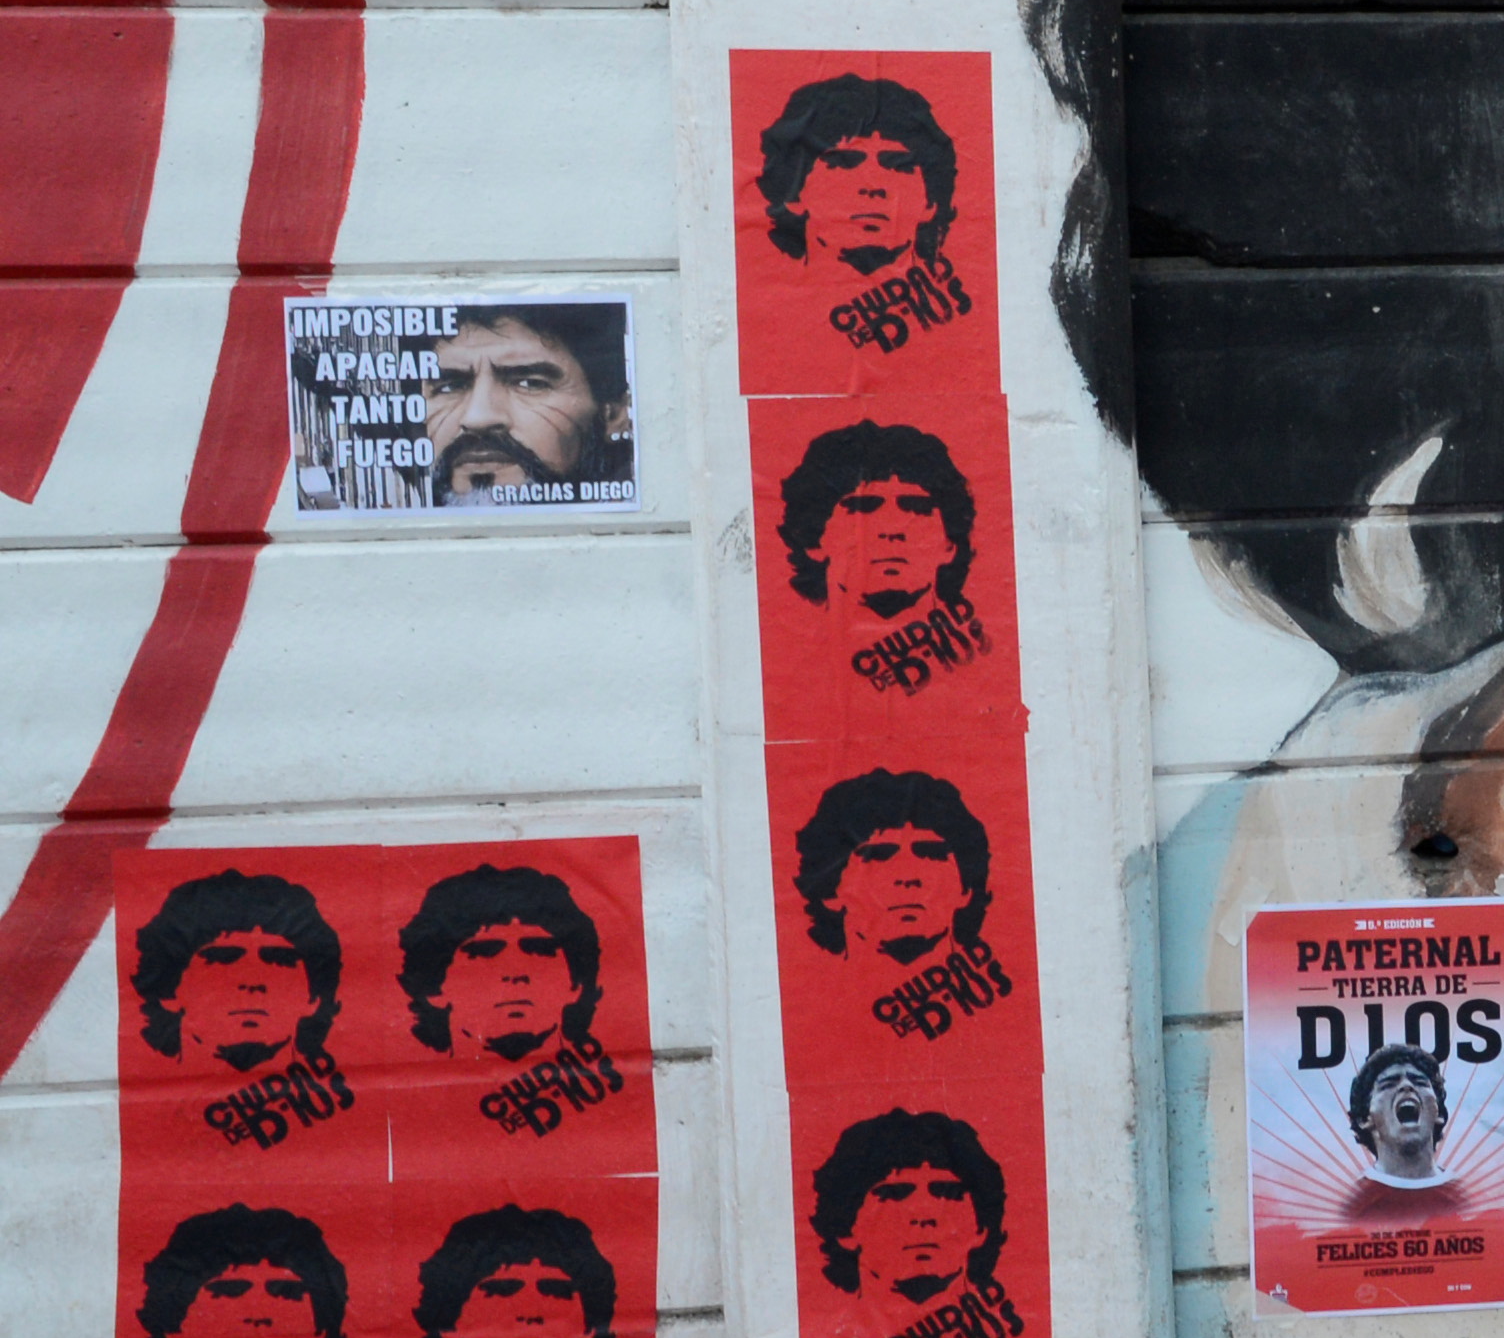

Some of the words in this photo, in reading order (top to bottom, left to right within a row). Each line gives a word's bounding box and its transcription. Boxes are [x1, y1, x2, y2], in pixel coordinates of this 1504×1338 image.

[293, 307, 459, 338] IMPOSIBLE
[315, 350, 440, 381] APAGAR
[331, 394, 427, 425] TANTO
[337, 437, 435, 469] FUEGO
[492, 481, 575, 503] GRACIAS
[579, 479, 636, 501] DIEGO
[1296, 935, 1502, 972] PATERNAL
[1332, 975, 1427, 998] TIERRA
[1435, 974, 1467, 995] DE
[1316, 1240, 1399, 1262] FELICES
[1403, 1239, 1429, 1258] 60
[1433, 1234, 1485, 1257] AÑOS
